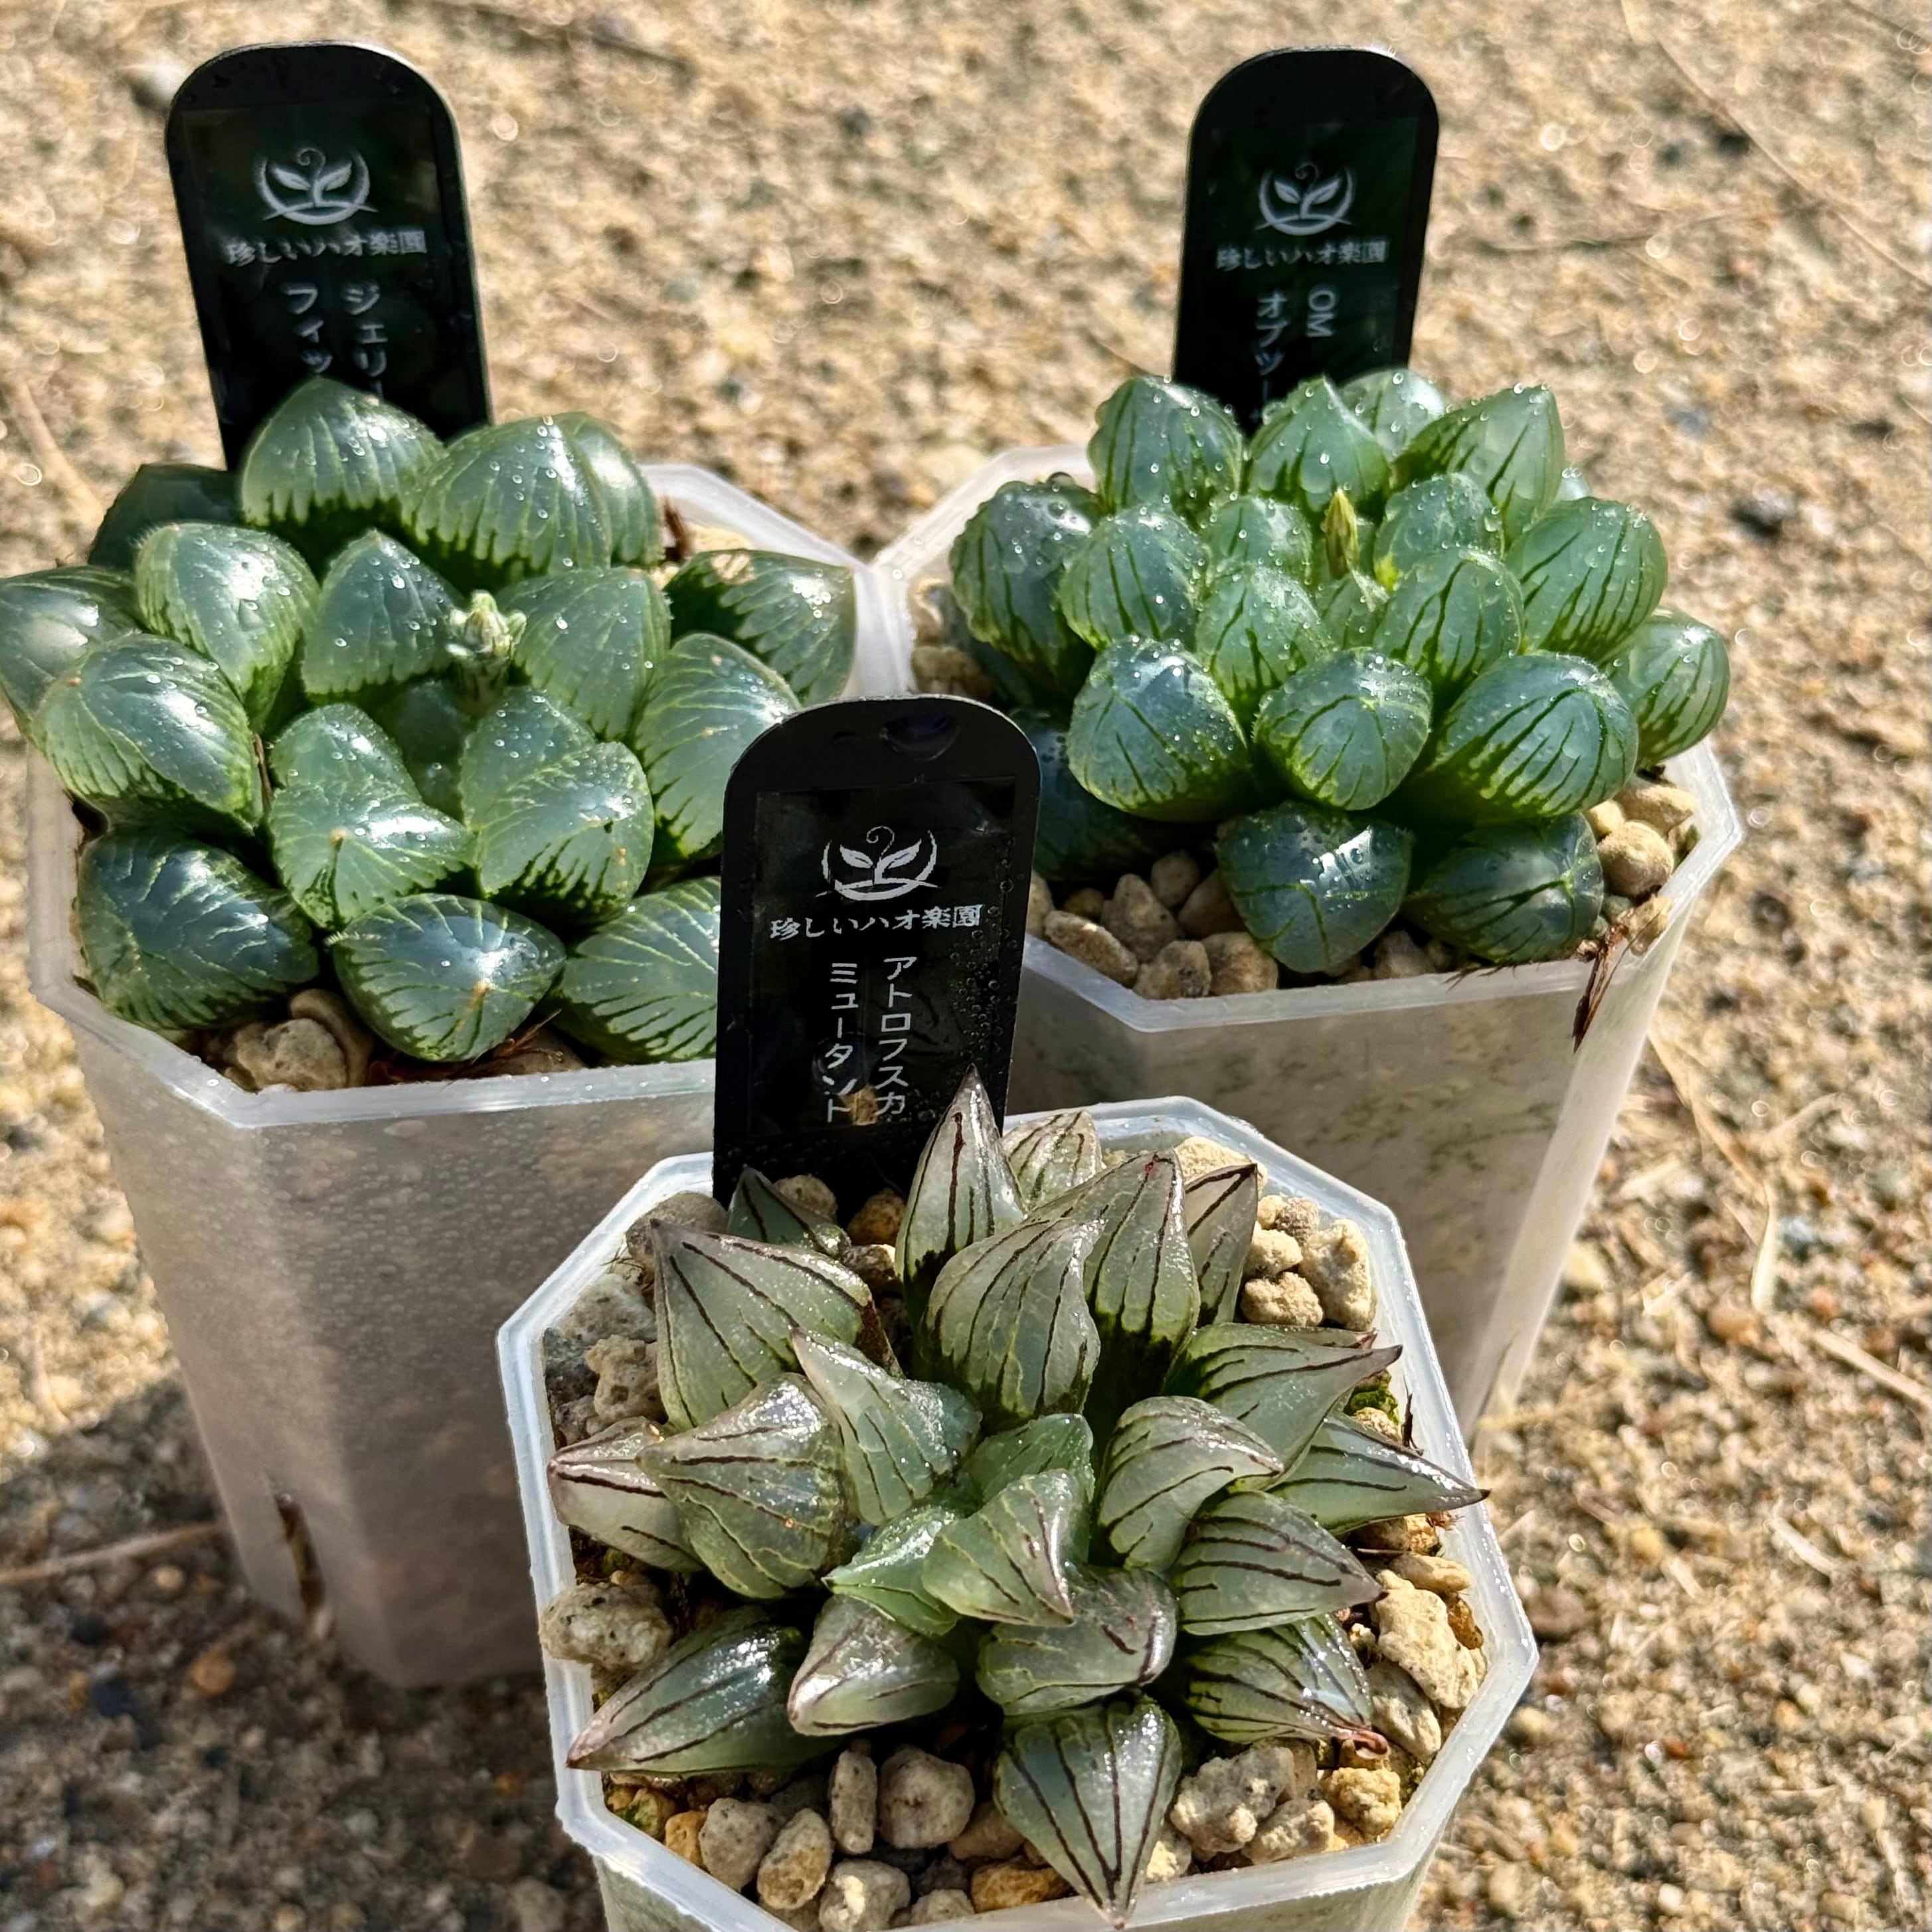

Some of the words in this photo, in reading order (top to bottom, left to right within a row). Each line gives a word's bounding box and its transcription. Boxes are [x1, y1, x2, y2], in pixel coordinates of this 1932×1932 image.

[226, 230, 428, 266] 珍しいハオ楽園
[1306, 287, 1336, 338] OM
[770, 904, 983, 940] 珍しいハオ楽園
[823, 962, 859, 1124] ミュータント
[875, 956, 917, 1115] アトロフスカ
